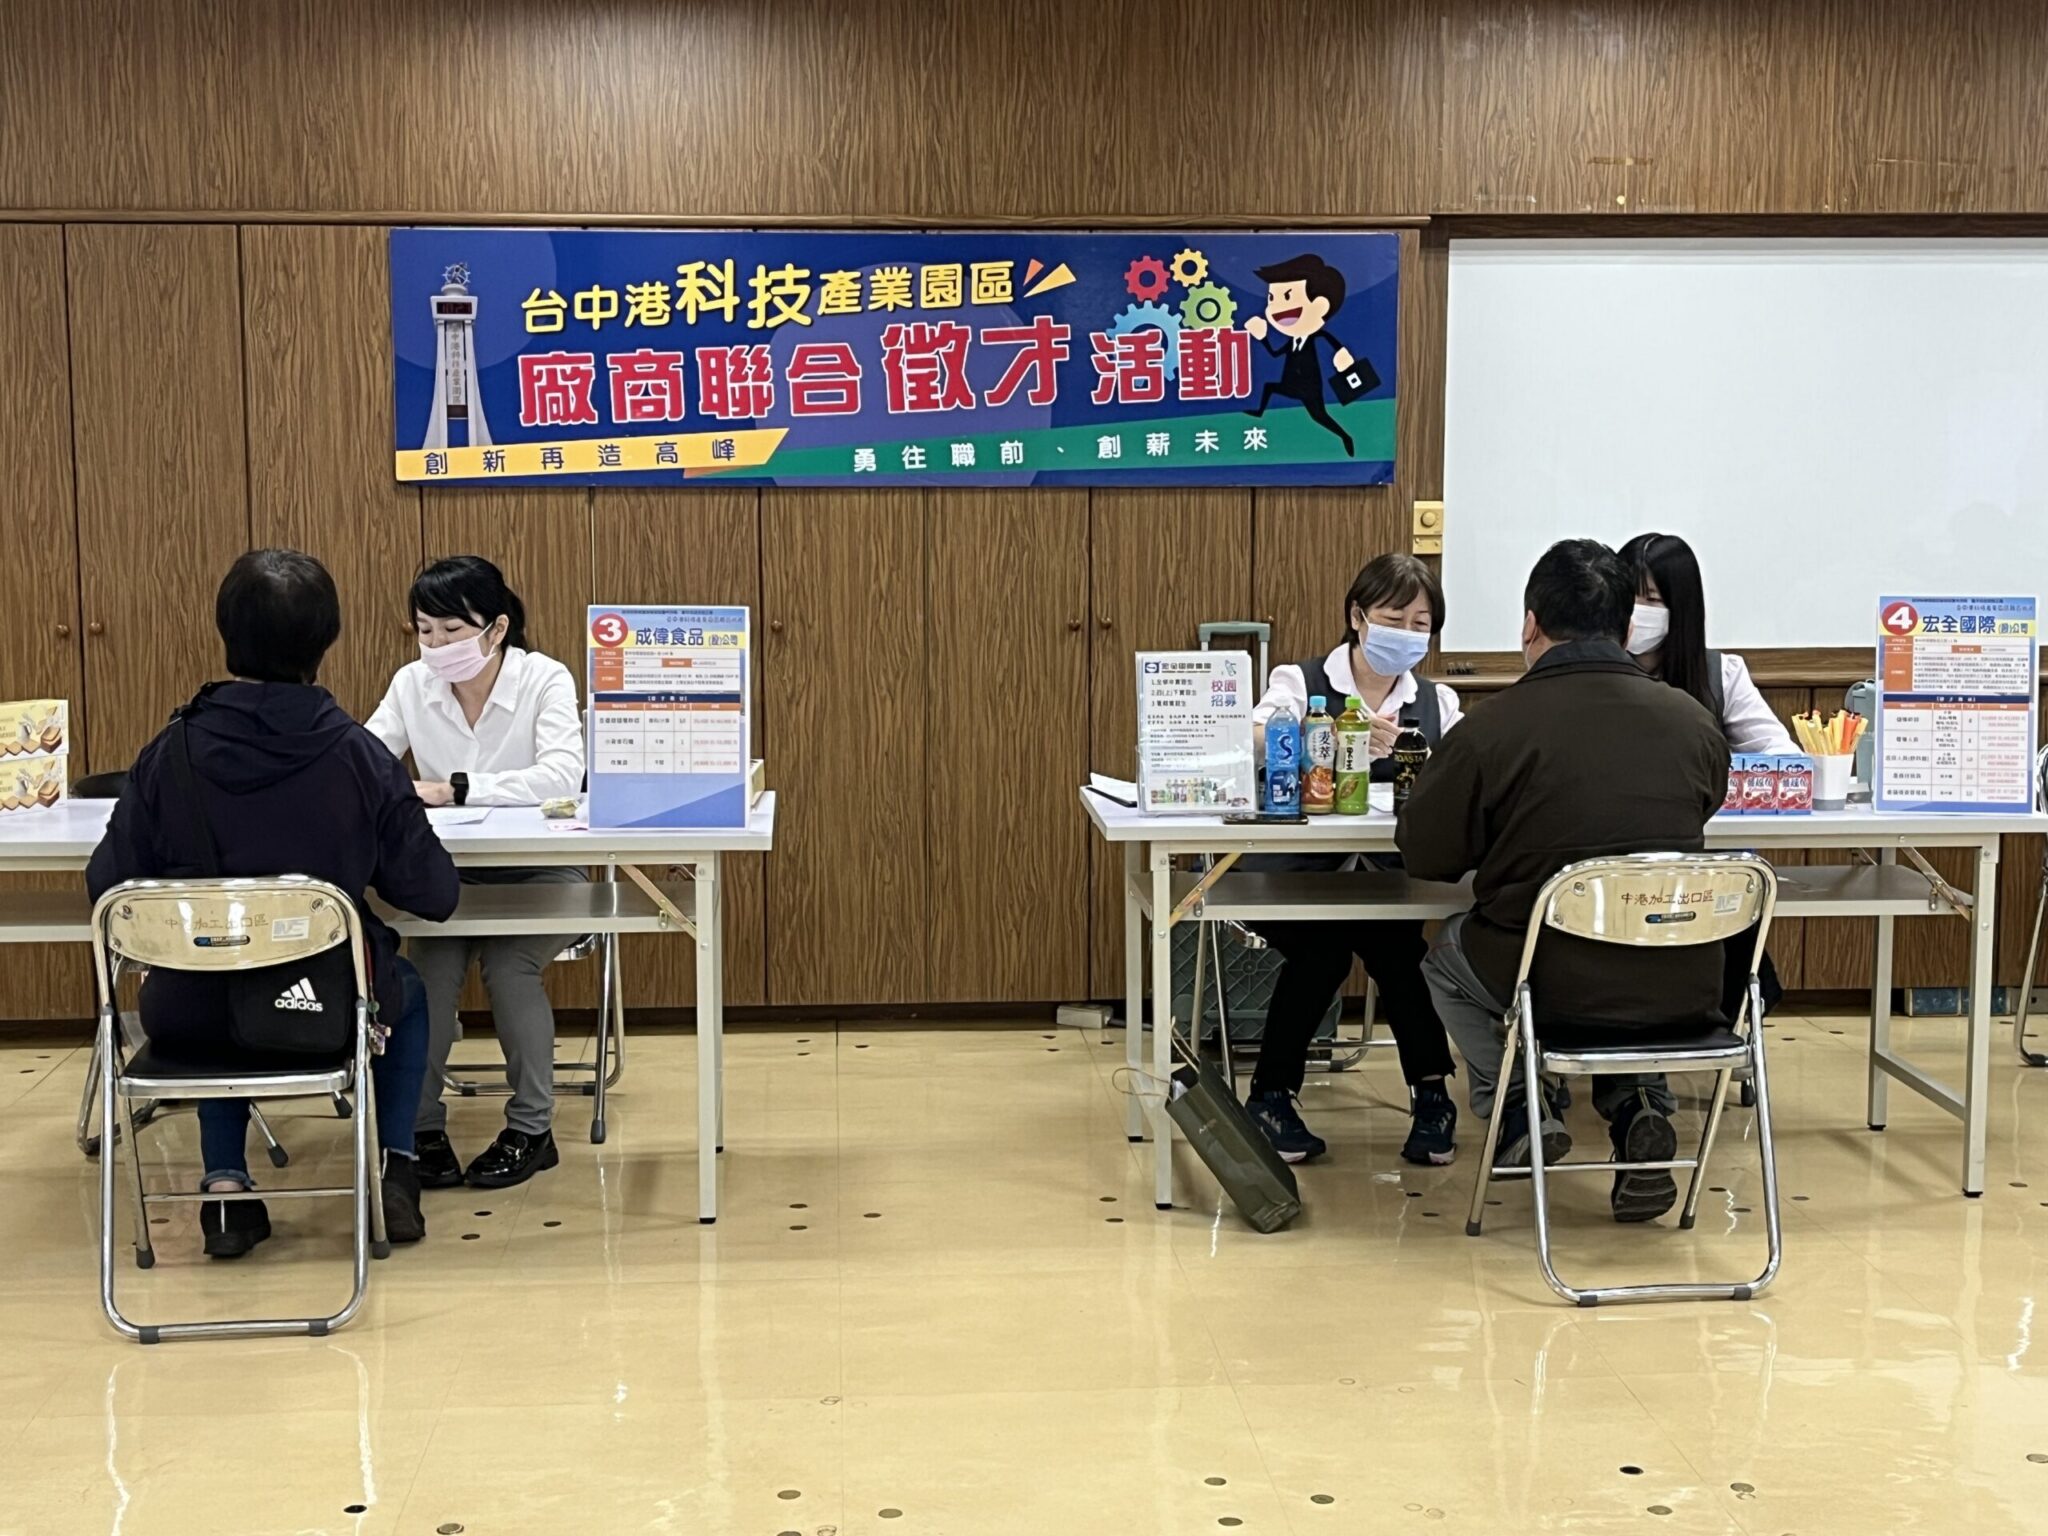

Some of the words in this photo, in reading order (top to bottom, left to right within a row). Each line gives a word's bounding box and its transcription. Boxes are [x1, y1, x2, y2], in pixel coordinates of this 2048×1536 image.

[521, 258, 1015, 334] 台中港科技產業園區
[517, 315, 1252, 427] 廠商聯合徵才活動
[424, 438, 736, 476] 創新再造高峰
[854, 426, 1268, 473] 勇往職前、創薪未來
[599, 618, 622, 642] 3
[1888, 606, 1913, 630] 4
[164, 913, 269, 930] 中加工出口區
[274, 996, 324, 1012] adidas
